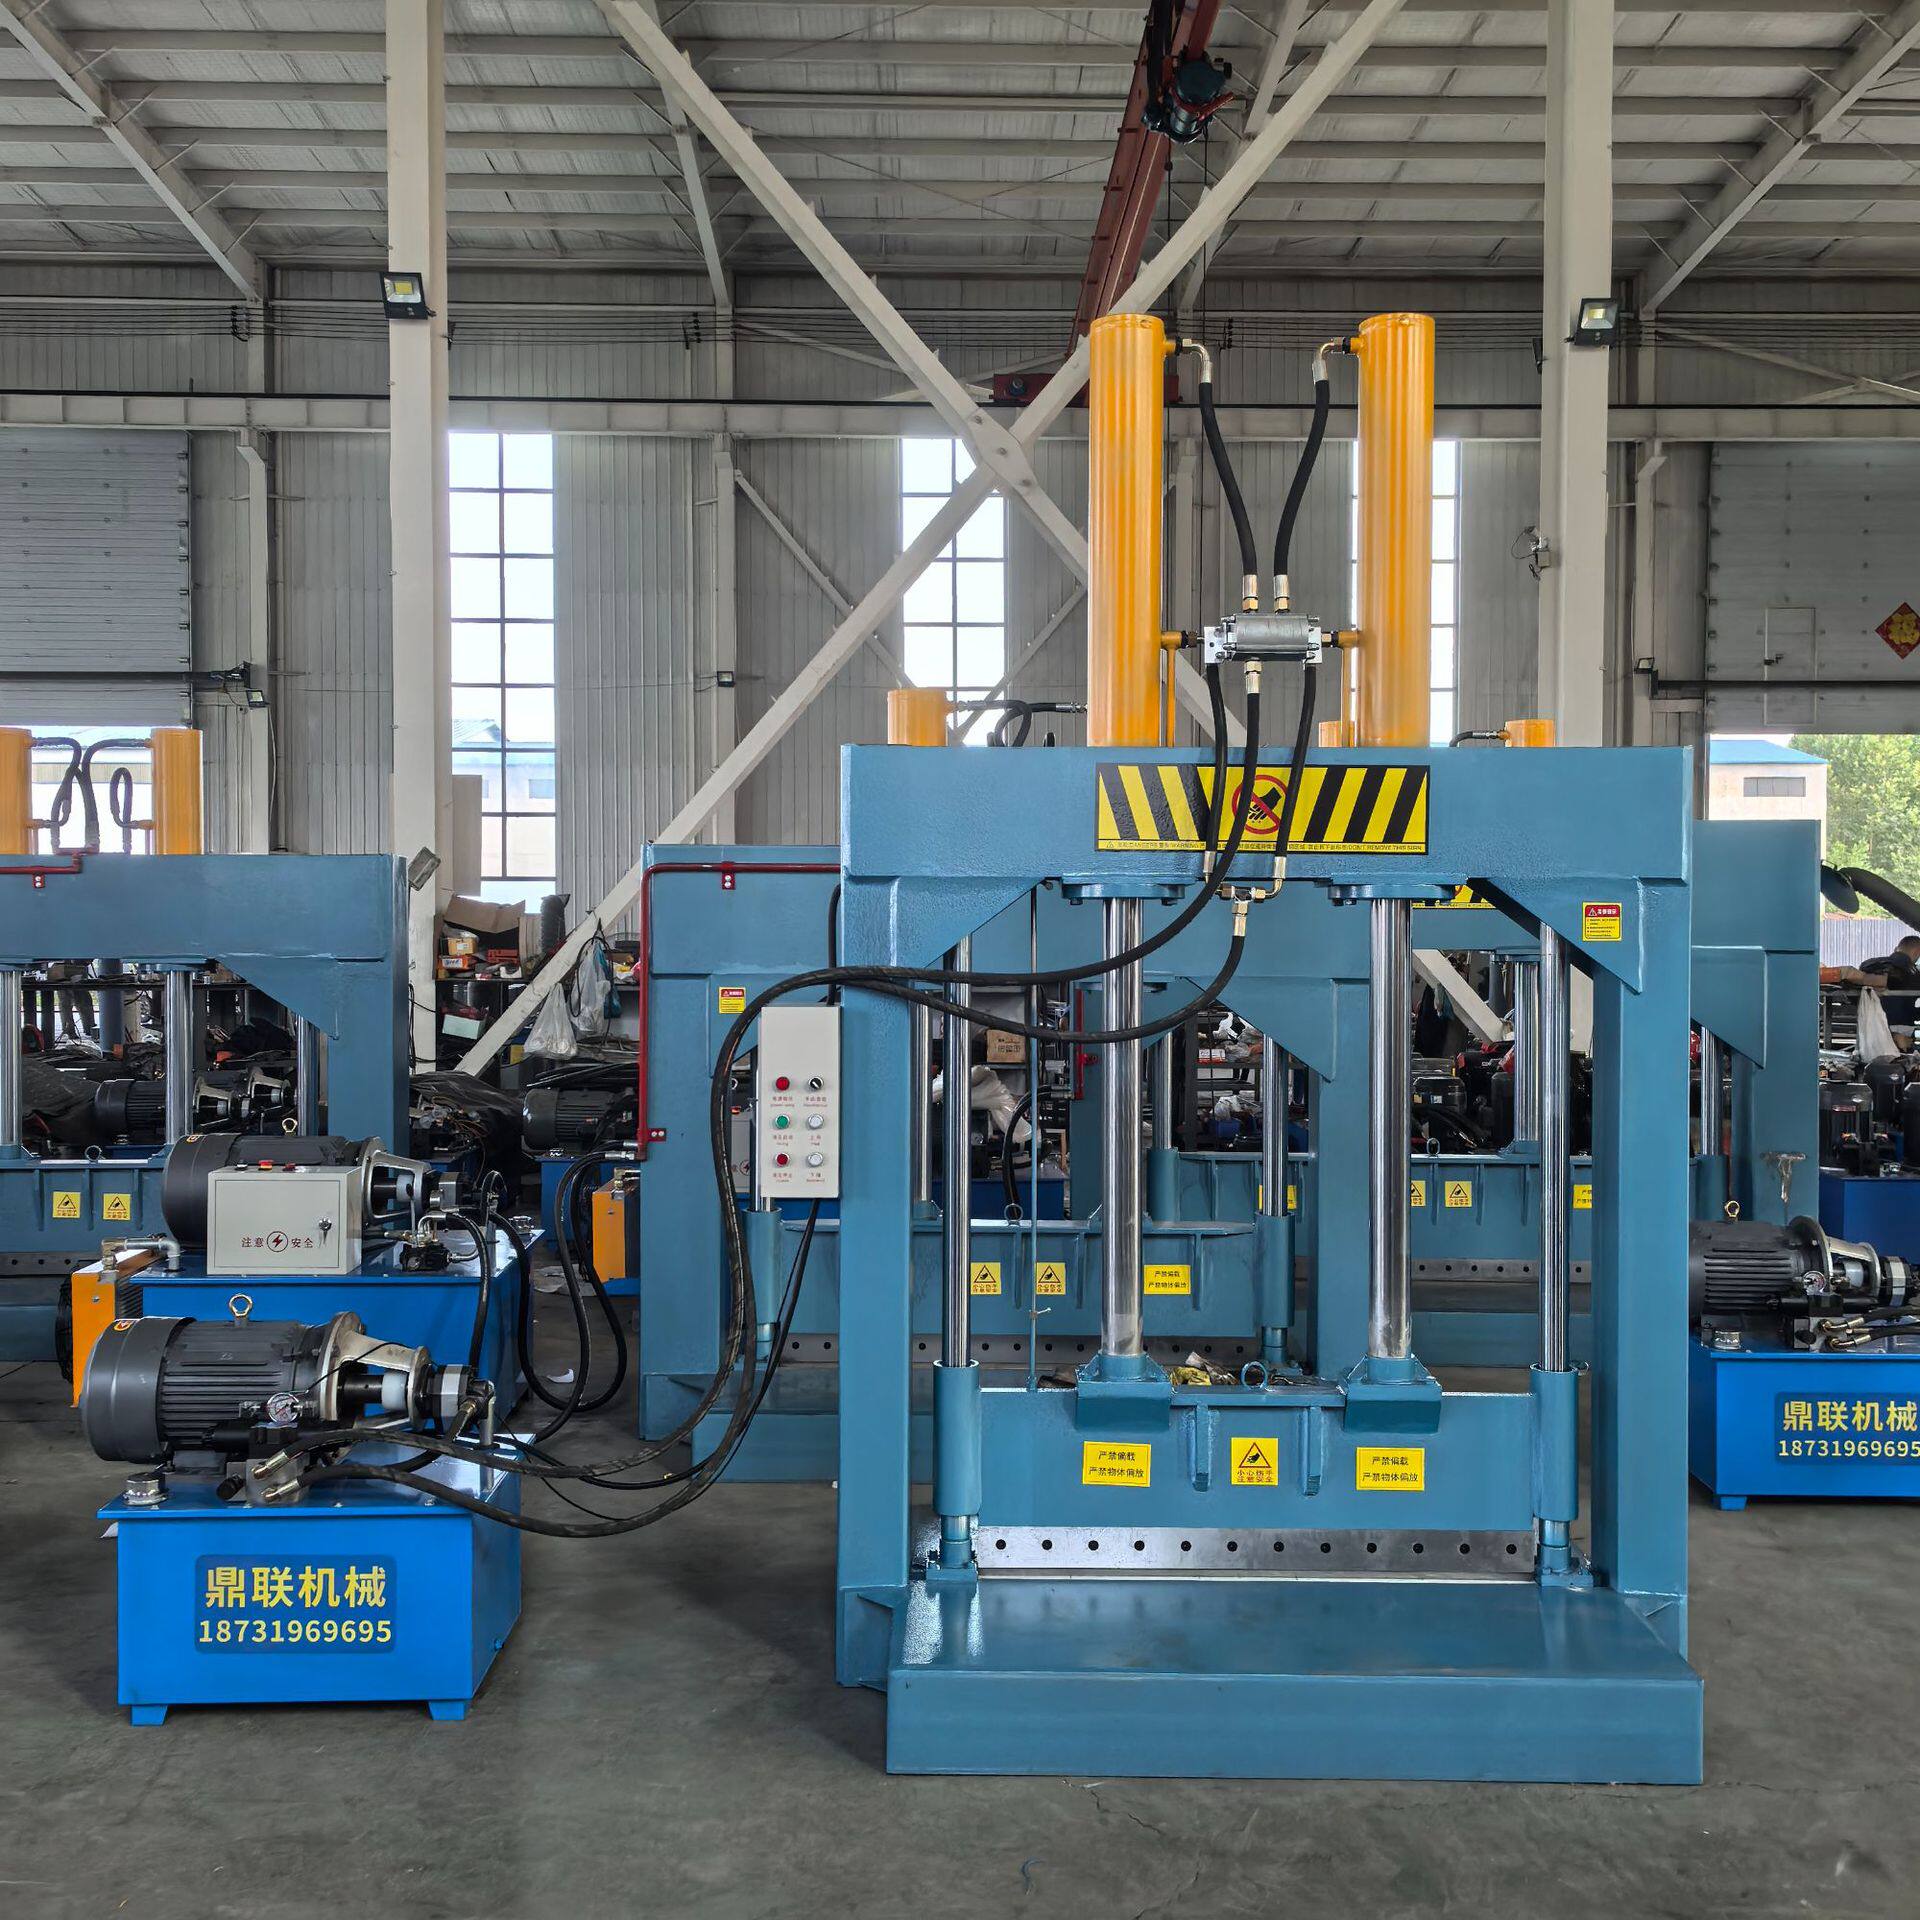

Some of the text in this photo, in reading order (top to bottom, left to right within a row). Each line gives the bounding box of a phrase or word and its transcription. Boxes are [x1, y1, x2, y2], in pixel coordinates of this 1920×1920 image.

[241, 1236, 314, 1249] 注意 安全
[1782, 1400, 1918, 1432] 鼎联机械
[1778, 1439, 1920, 1457] 18731969695
[1098, 1450, 1136, 1462] 严禁偏载
[1372, 1455, 1409, 1466] 严禁偏载
[1088, 1466, 1144, 1478] 严禁物体偏放
[1361, 1471, 1419, 1482] 严禁物体偏放
[205, 1565, 387, 1608] 鼎联机械
[199, 1619, 392, 1643] 18731969695
